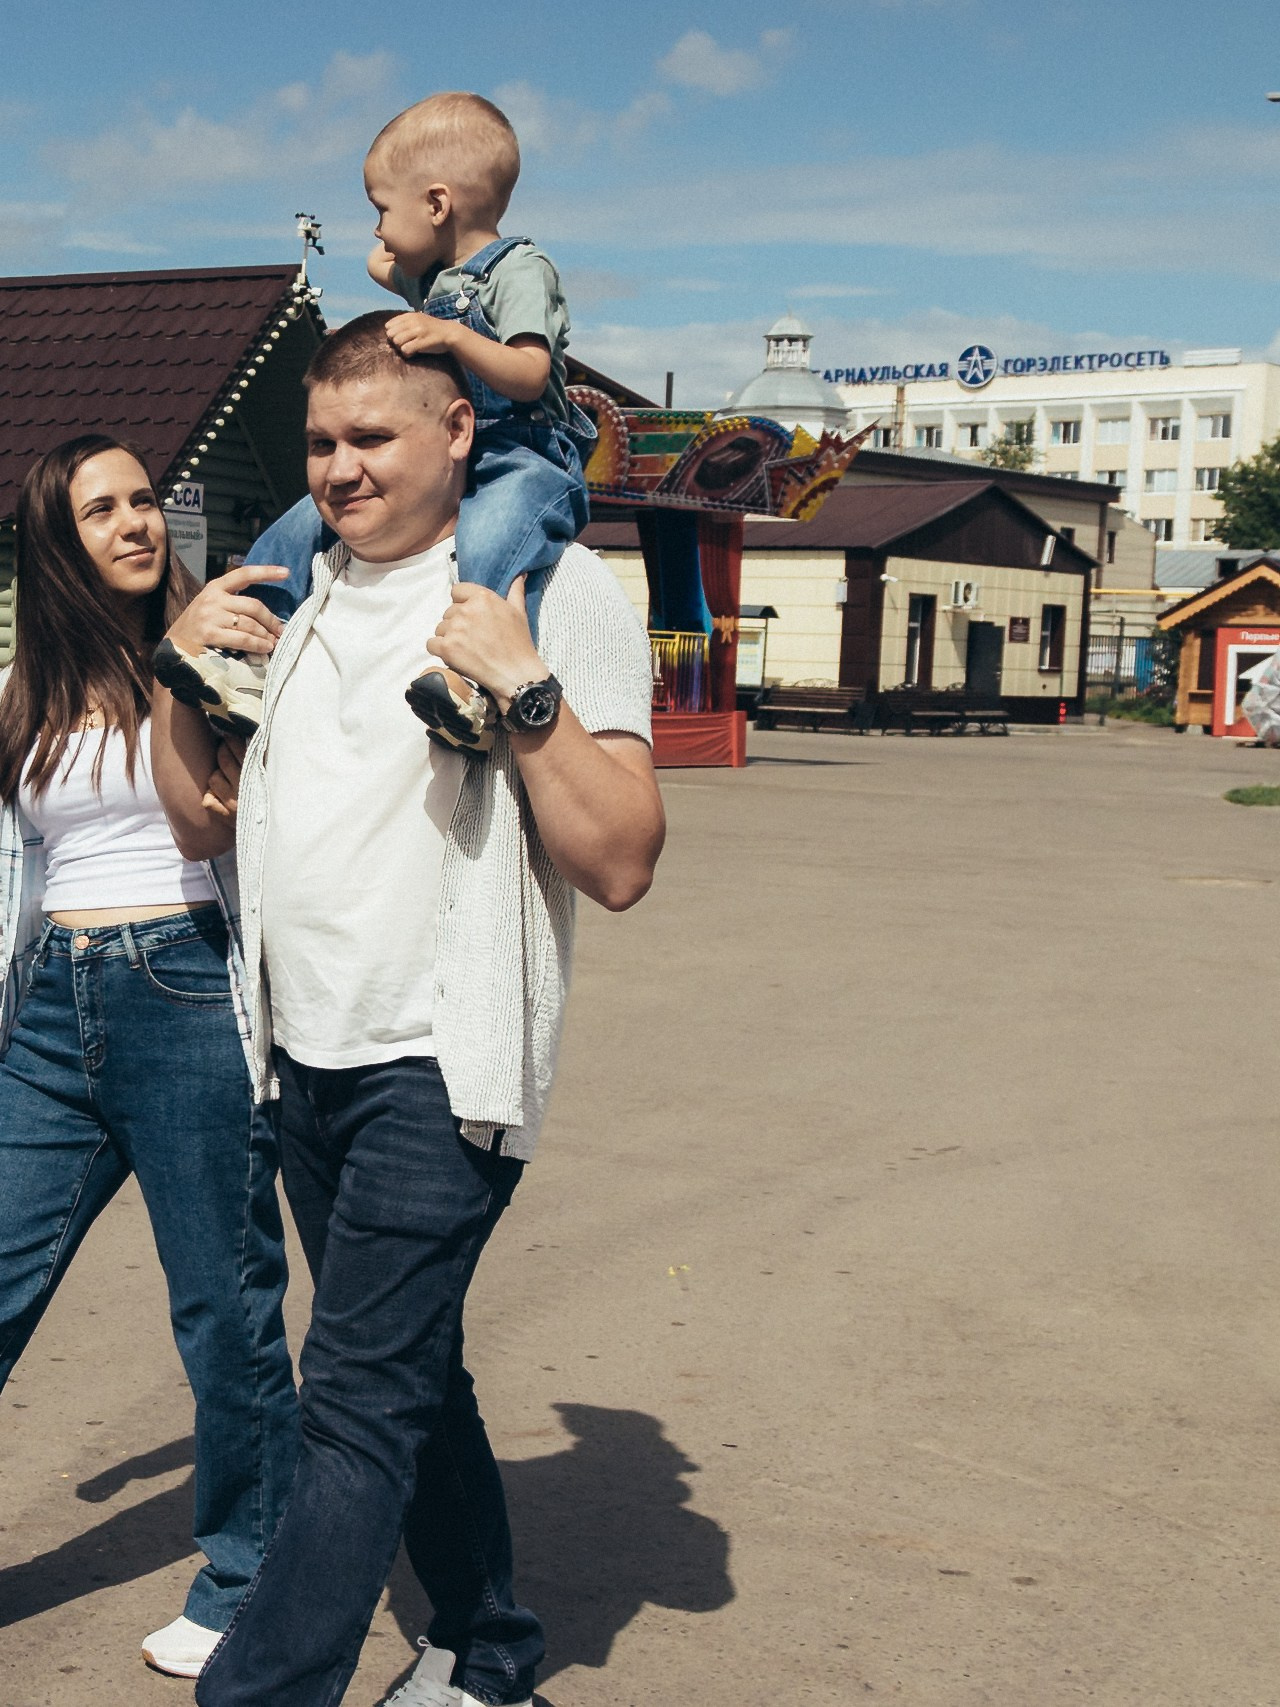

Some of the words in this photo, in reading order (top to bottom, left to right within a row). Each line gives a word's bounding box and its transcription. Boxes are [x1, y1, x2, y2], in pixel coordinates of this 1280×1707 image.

[812, 362, 949, 384] АРНАУЛЬСКАЯ
[1004, 350, 1170, 374] ГОРЭЛЕКТРОСЕТЬ
[173, 486, 200, 508] ССА
